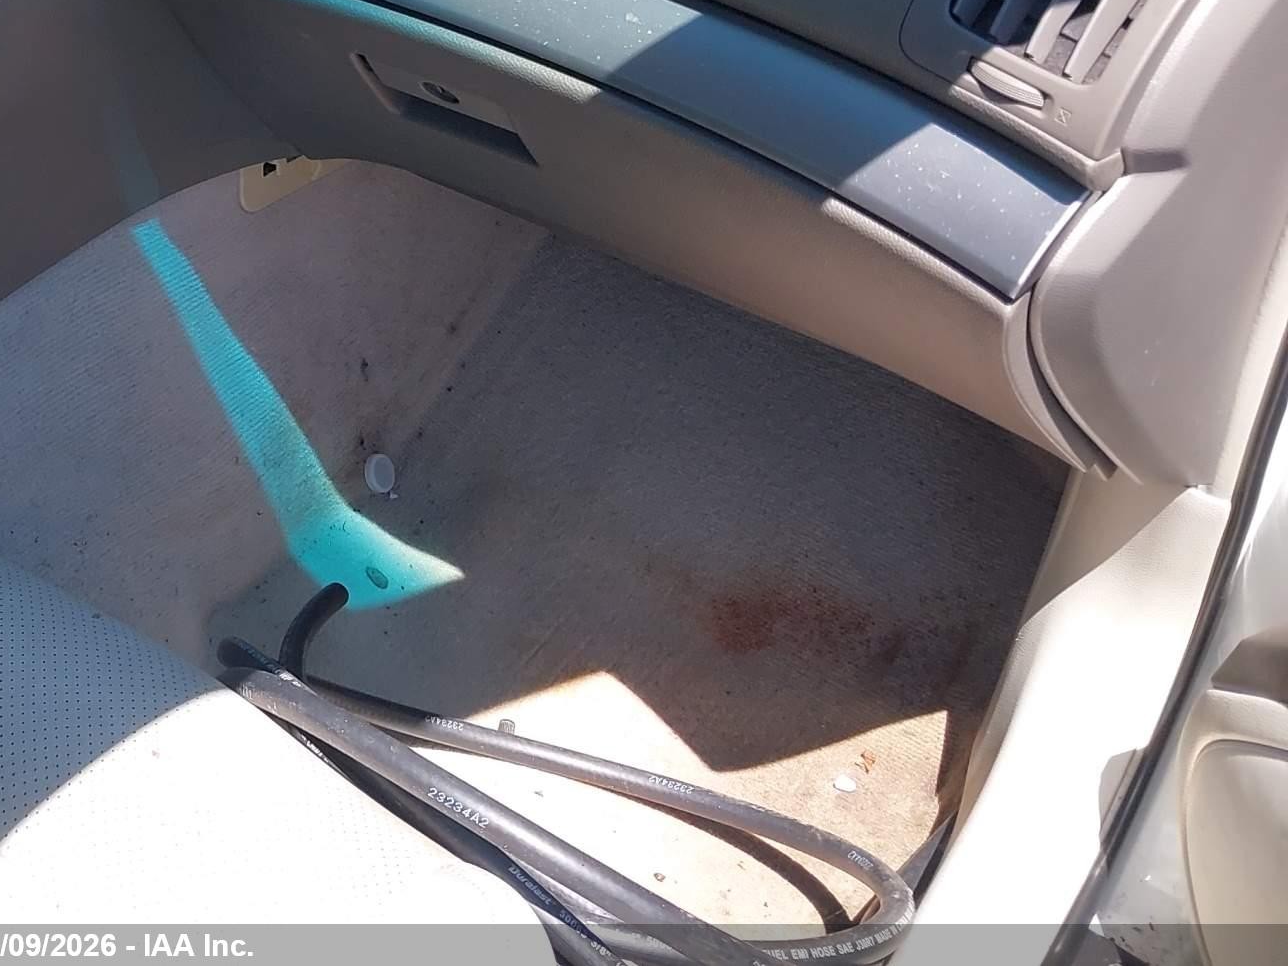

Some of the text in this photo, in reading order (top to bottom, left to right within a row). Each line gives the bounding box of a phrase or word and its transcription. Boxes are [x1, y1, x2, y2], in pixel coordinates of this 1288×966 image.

[428, 787, 489, 829] 23234A2
[508, 865, 554, 906] Duralast
[811, 945, 837, 960] HOSE
[836, 942, 855, 956] SAE
